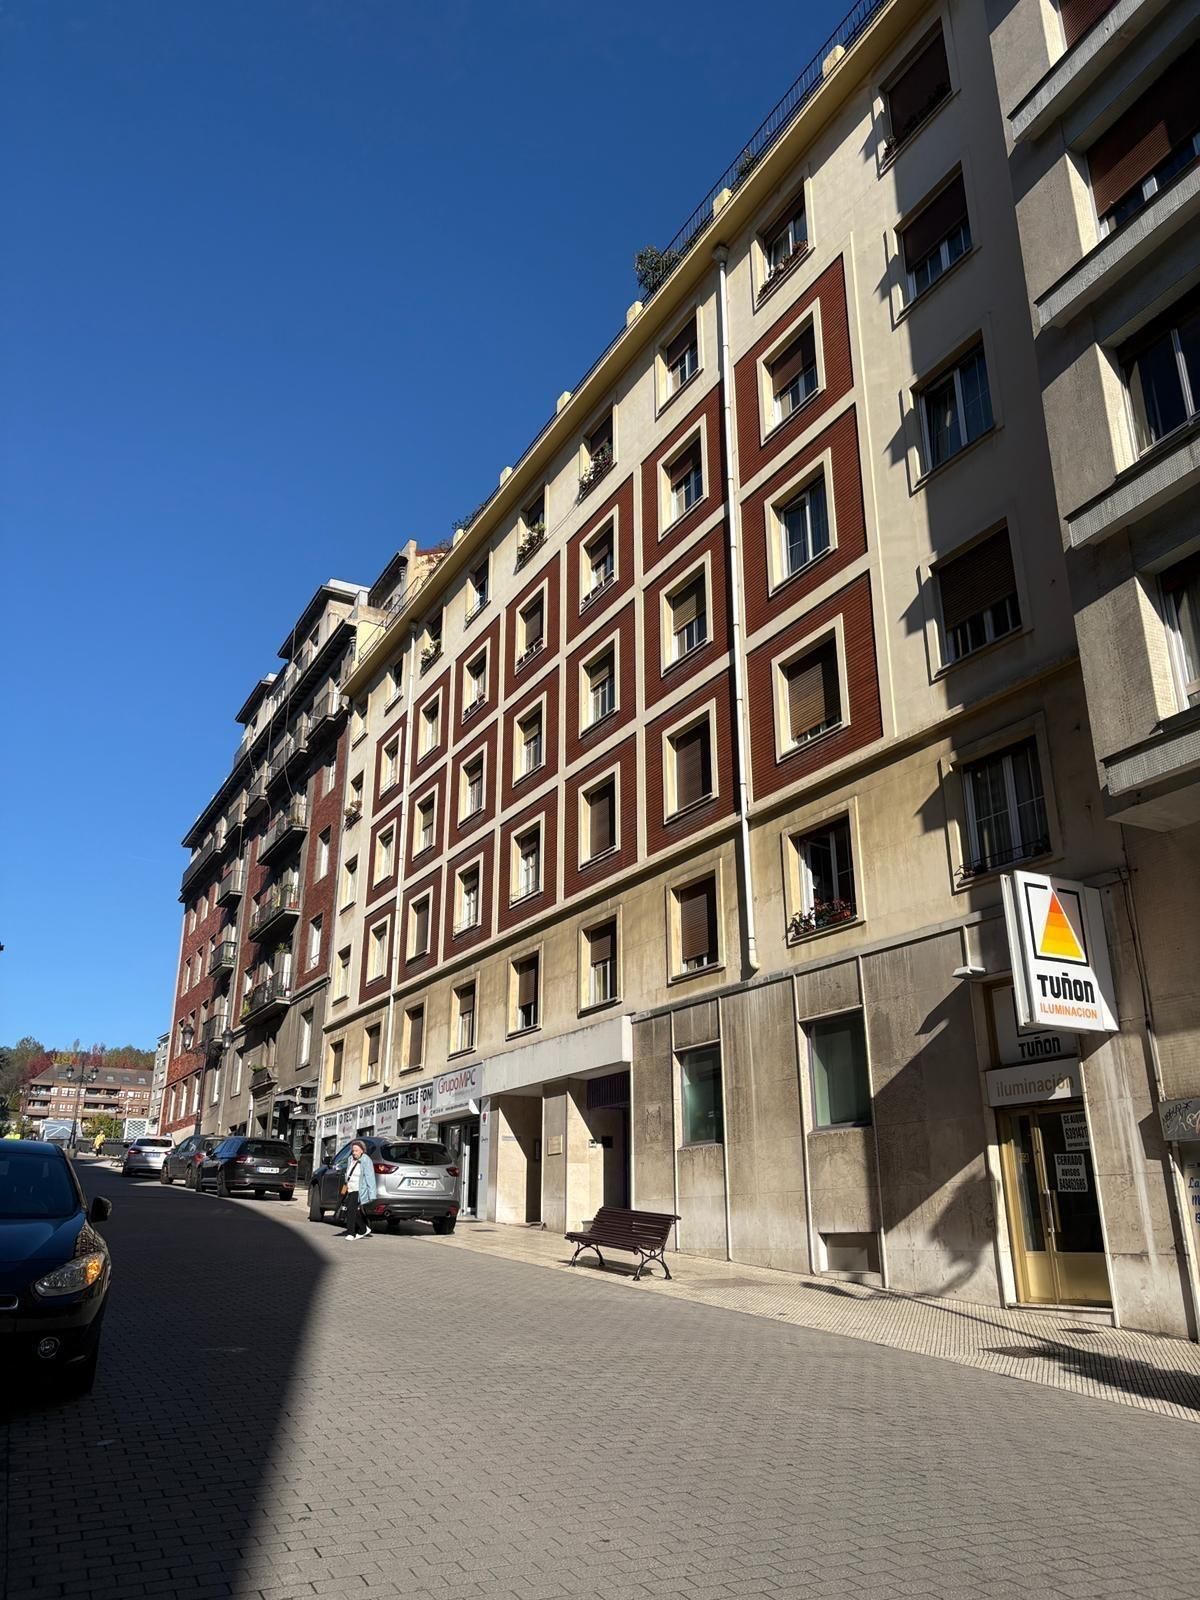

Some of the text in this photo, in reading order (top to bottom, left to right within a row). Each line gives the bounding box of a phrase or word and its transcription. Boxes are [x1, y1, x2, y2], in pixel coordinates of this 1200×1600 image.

[1037, 972, 1096, 1003] TUÑON
[1040, 1002, 1098, 1020] ILUMINACION
[995, 1073, 1074, 1097] iluminación
[1056, 1155, 1083, 1166] CERRADO
